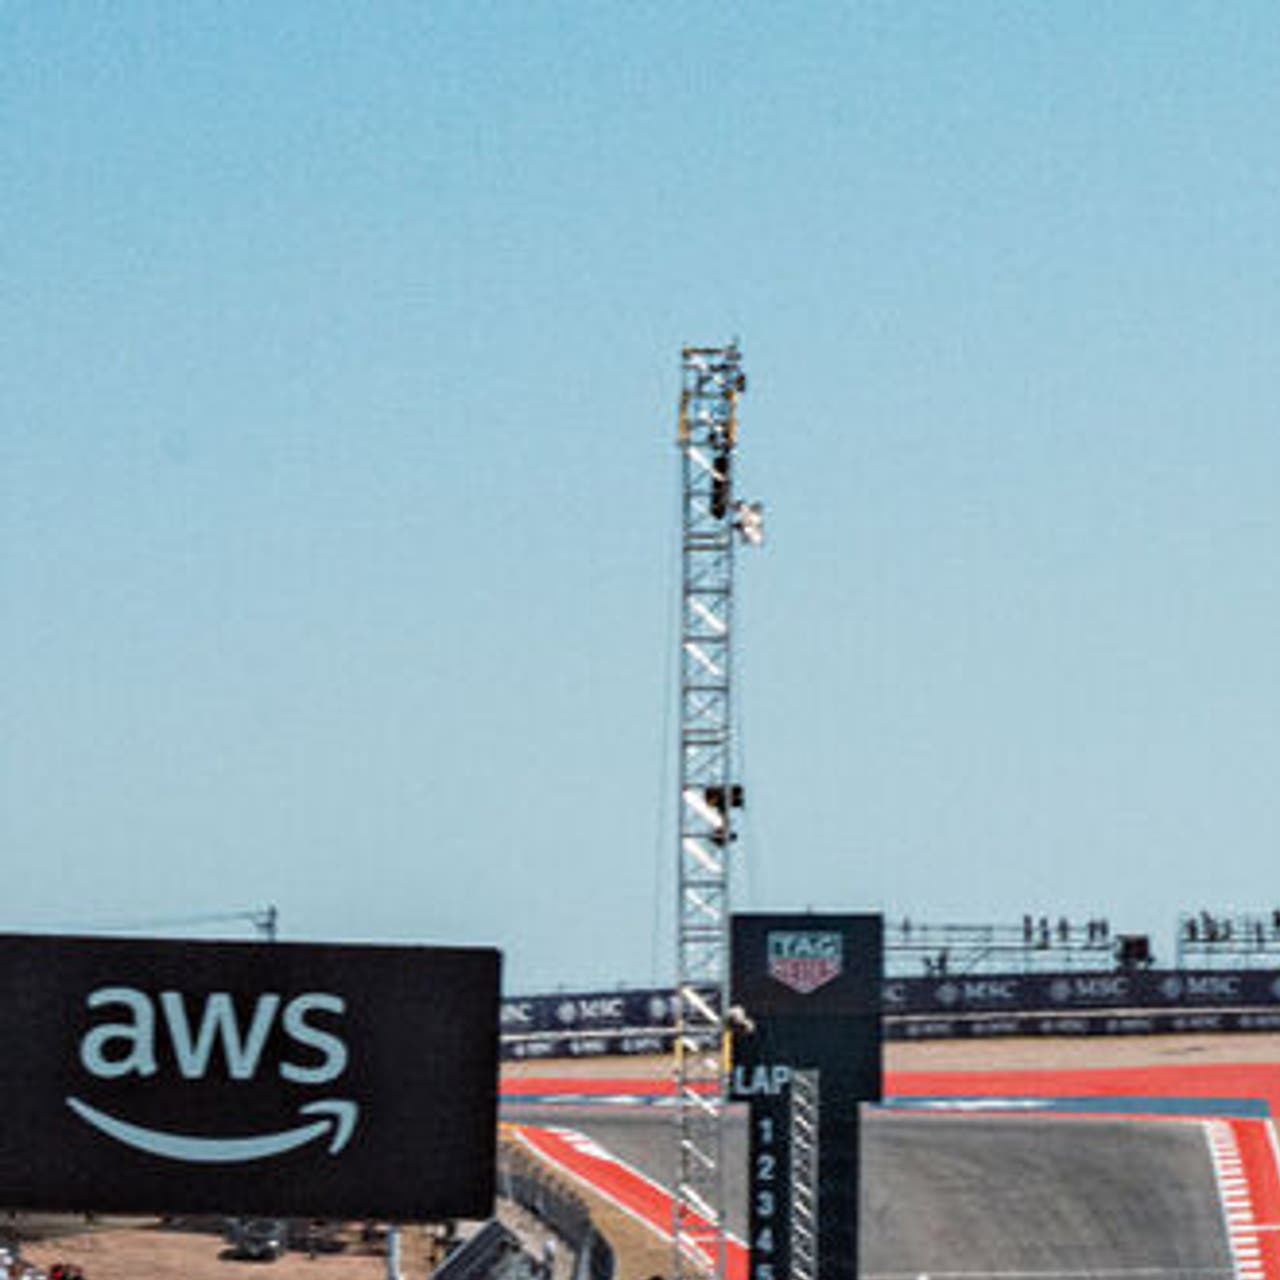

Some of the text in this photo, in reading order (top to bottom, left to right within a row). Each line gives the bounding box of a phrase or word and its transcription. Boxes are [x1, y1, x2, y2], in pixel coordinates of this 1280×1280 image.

[79, 984, 349, 1084] aws
[734, 1065, 791, 1095] LAP
[758, 1116, 774, 1144] 1
[756, 1154, 776, 1181] 2
[756, 1191, 775, 1217] 3
[756, 1227, 774, 1253] 4
